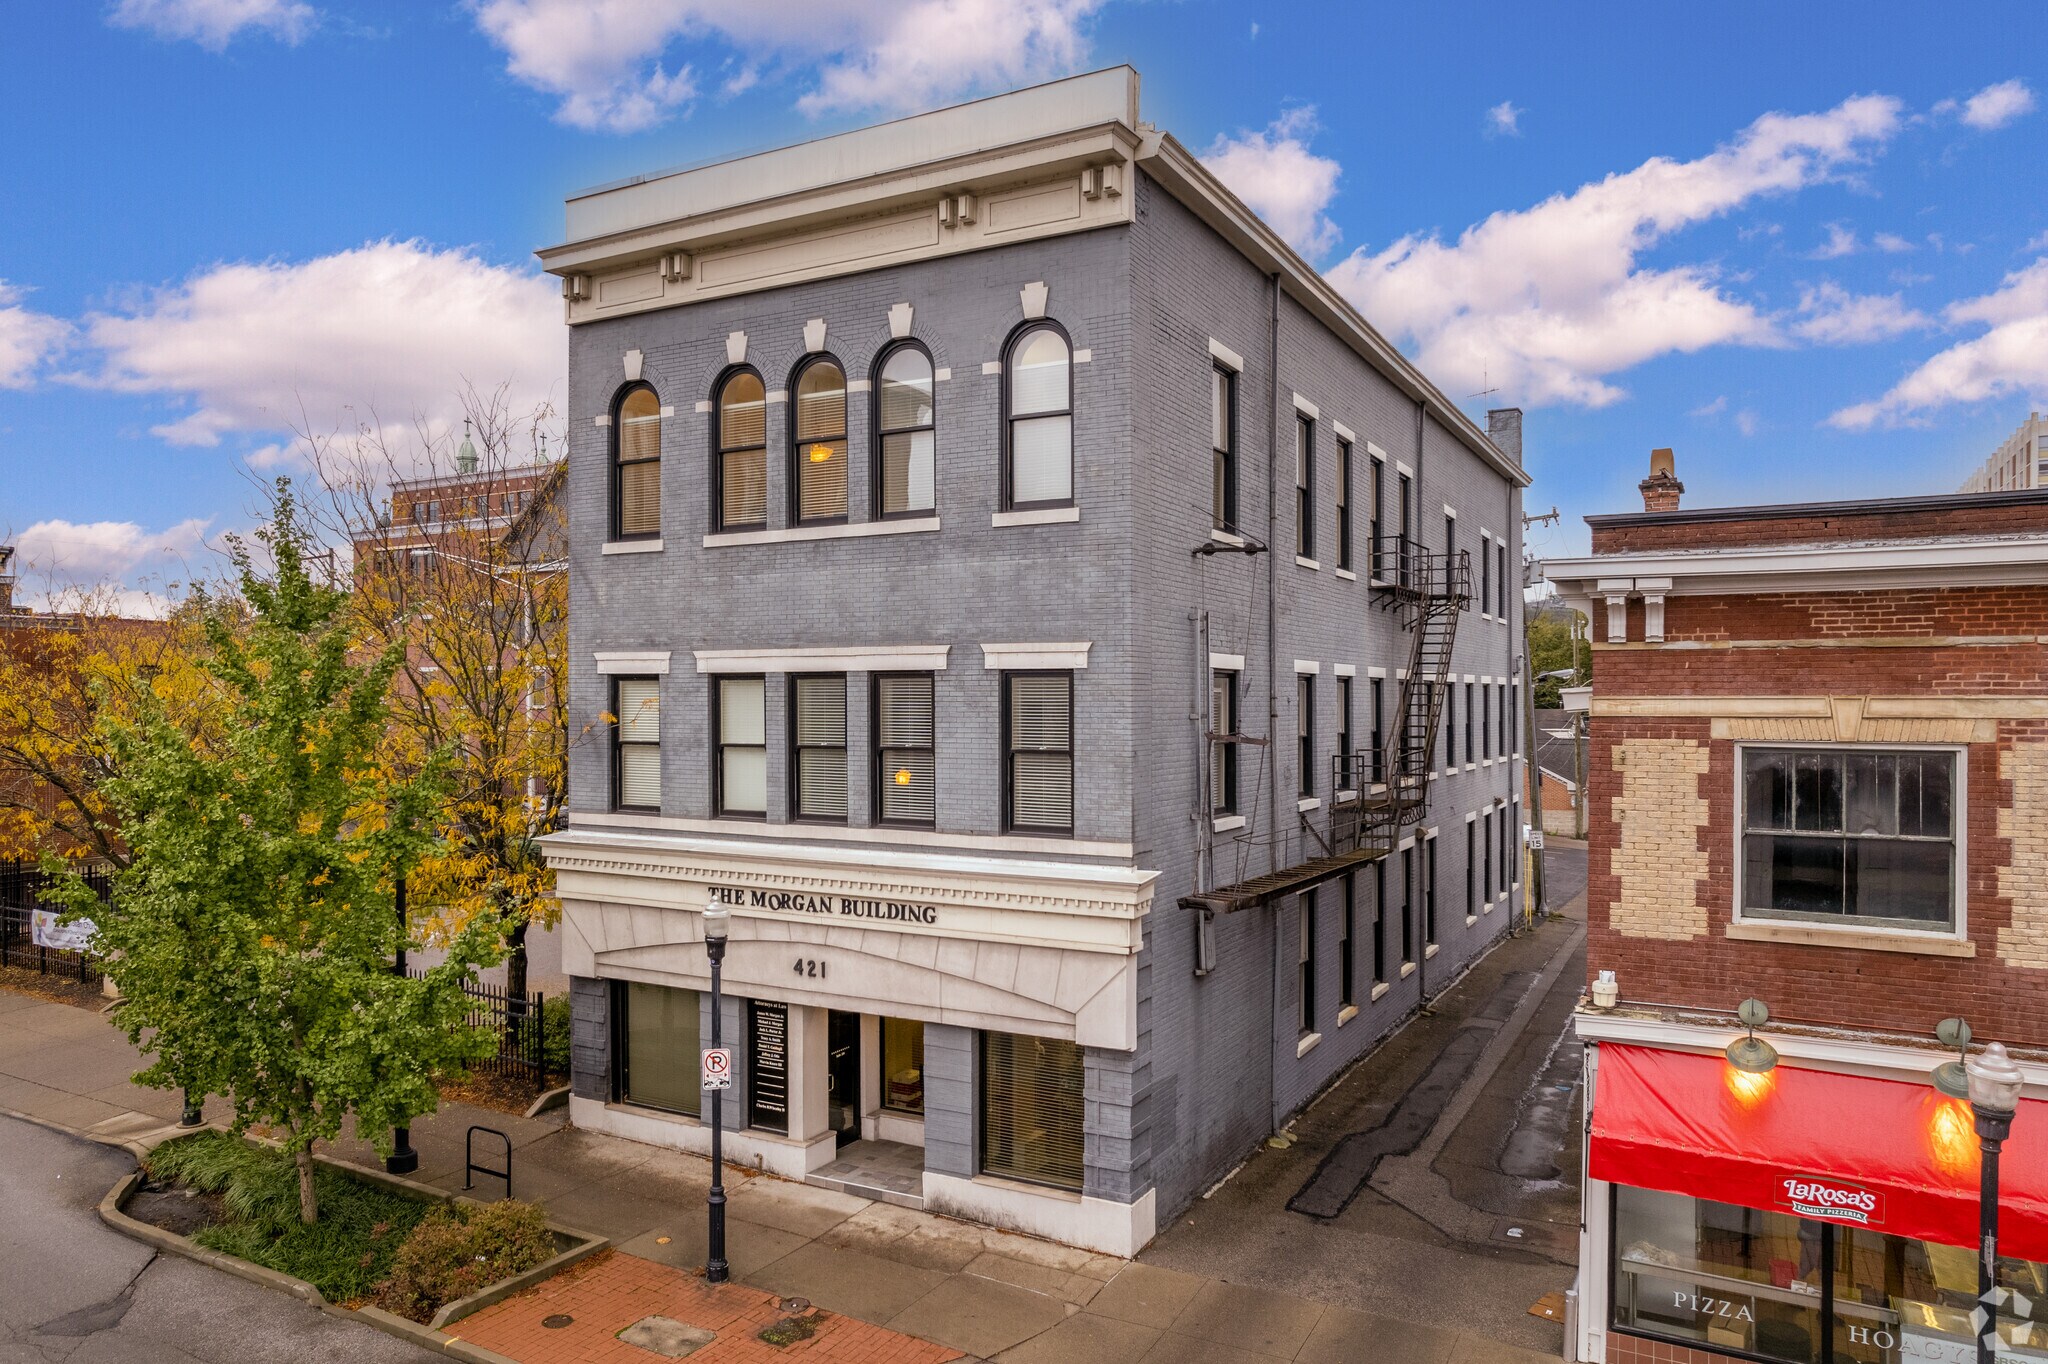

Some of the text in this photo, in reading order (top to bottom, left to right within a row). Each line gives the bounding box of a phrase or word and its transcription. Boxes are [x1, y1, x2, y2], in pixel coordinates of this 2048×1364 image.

[708, 886, 938, 924] THE MORGAN BUILDING
[793, 958, 827, 979] 421
[1783, 1179, 1876, 1211] LaRosa's
[1797, 1205, 1861, 1218] FAMILY PIZZERIA
[1673, 1291, 1755, 1323] PIZZA
